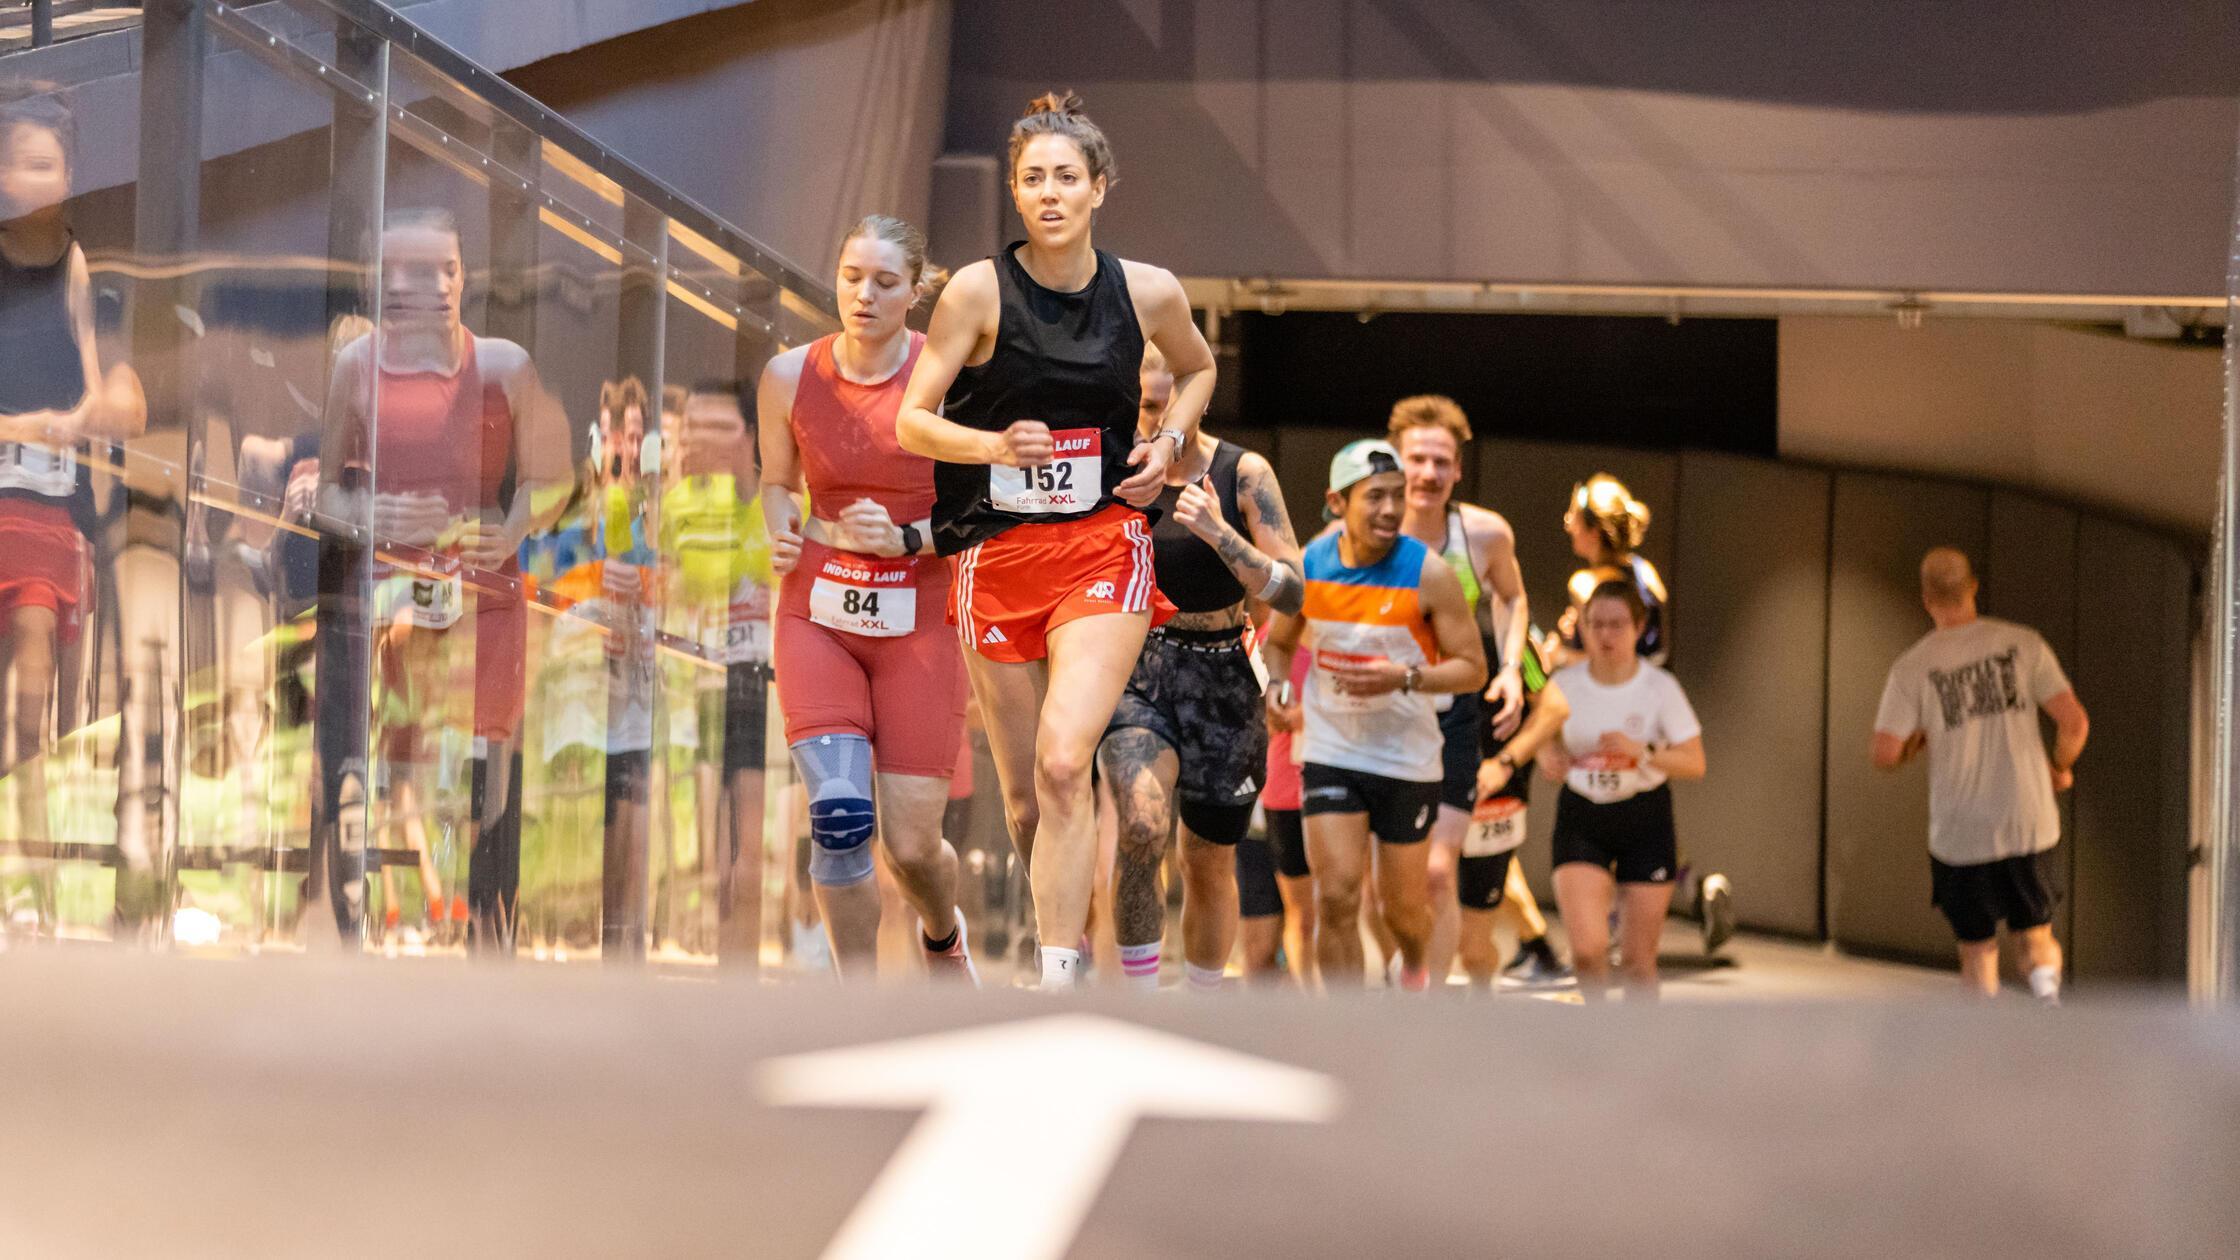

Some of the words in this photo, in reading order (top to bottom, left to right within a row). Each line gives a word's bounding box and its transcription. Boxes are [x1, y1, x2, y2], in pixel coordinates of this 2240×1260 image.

[1056, 438, 1091, 452] LAUF
[1019, 461, 1073, 492] 152
[1016, 496, 1047, 505] Fahrrad
[1048, 494, 1076, 505] XXL
[822, 562, 872, 582] INDOOR
[873, 570, 908, 583] LAUF
[842, 588, 880, 617] 84
[860, 618, 889, 630] XXL
